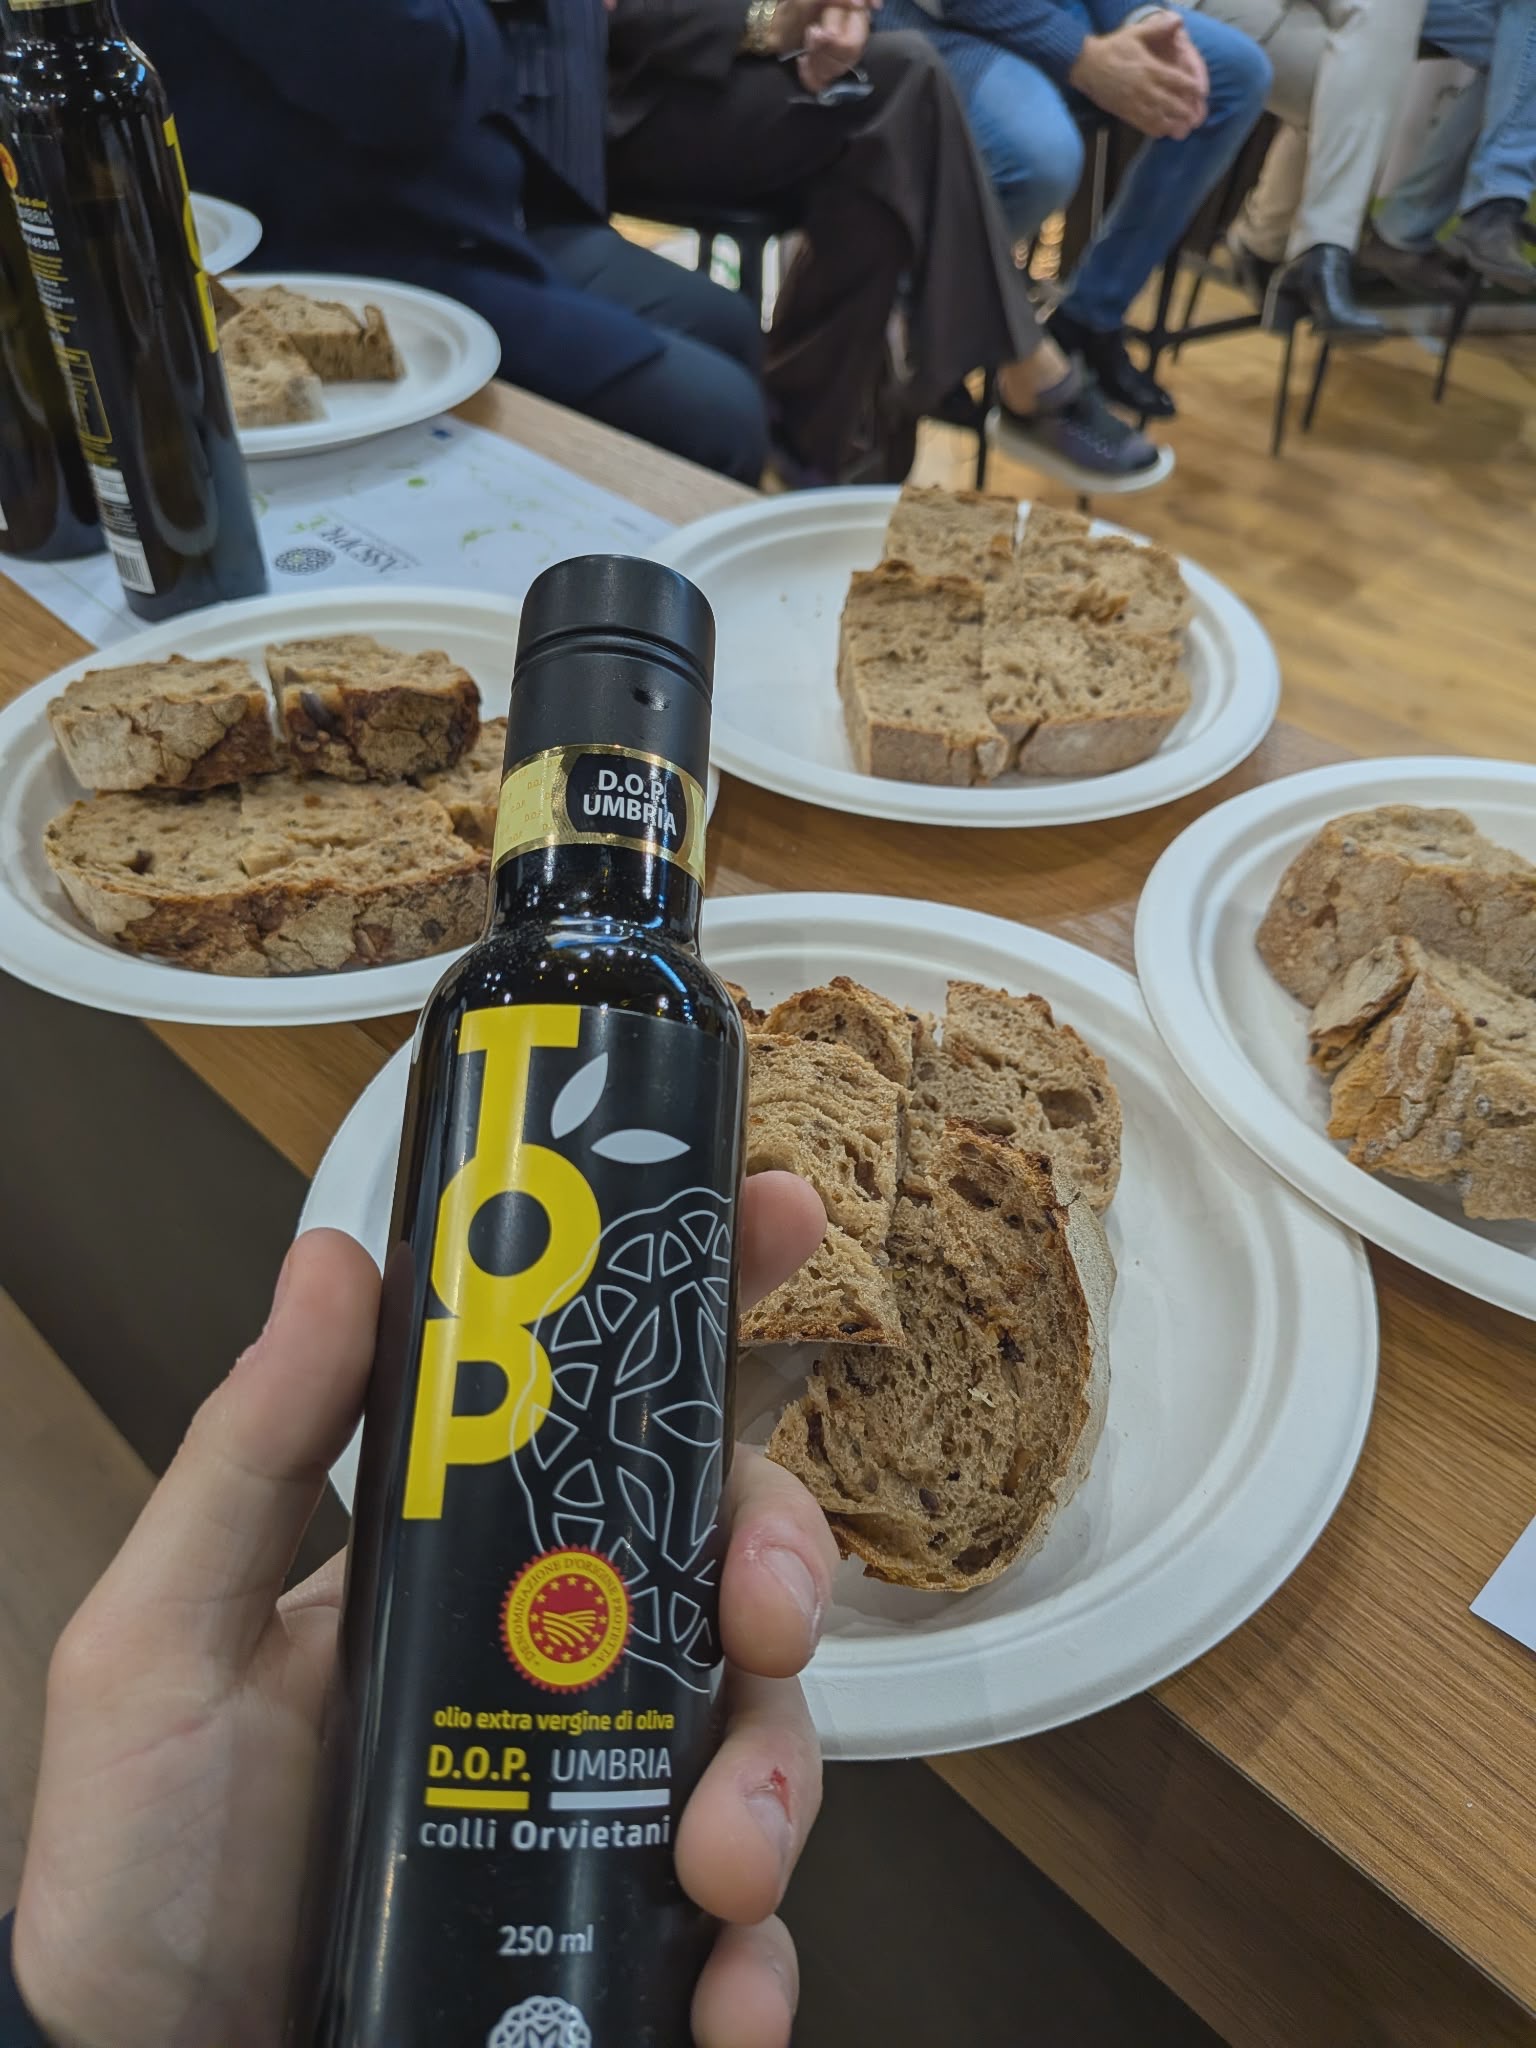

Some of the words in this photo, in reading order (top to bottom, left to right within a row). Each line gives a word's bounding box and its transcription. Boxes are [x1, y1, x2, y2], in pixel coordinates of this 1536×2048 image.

[598, 769, 667, 804] D.O.P.
[583, 794, 677, 836] UMBRIA
[402, 1004, 602, 1520] TOP
[434, 1706, 472, 1728] olio
[476, 1710, 532, 1730] extra
[536, 1710, 612, 1736] vergine
[614, 1710, 633, 1731] di
[636, 1710, 675, 1730] oliva
[428, 1744, 531, 1781] D.O.P.
[552, 1747, 672, 1781] UMBRIA
[420, 1817, 497, 1849] colli
[511, 1815, 671, 1850] Orvietani
[498, 1924, 554, 1956] 250
[559, 1923, 594, 1953] ml
